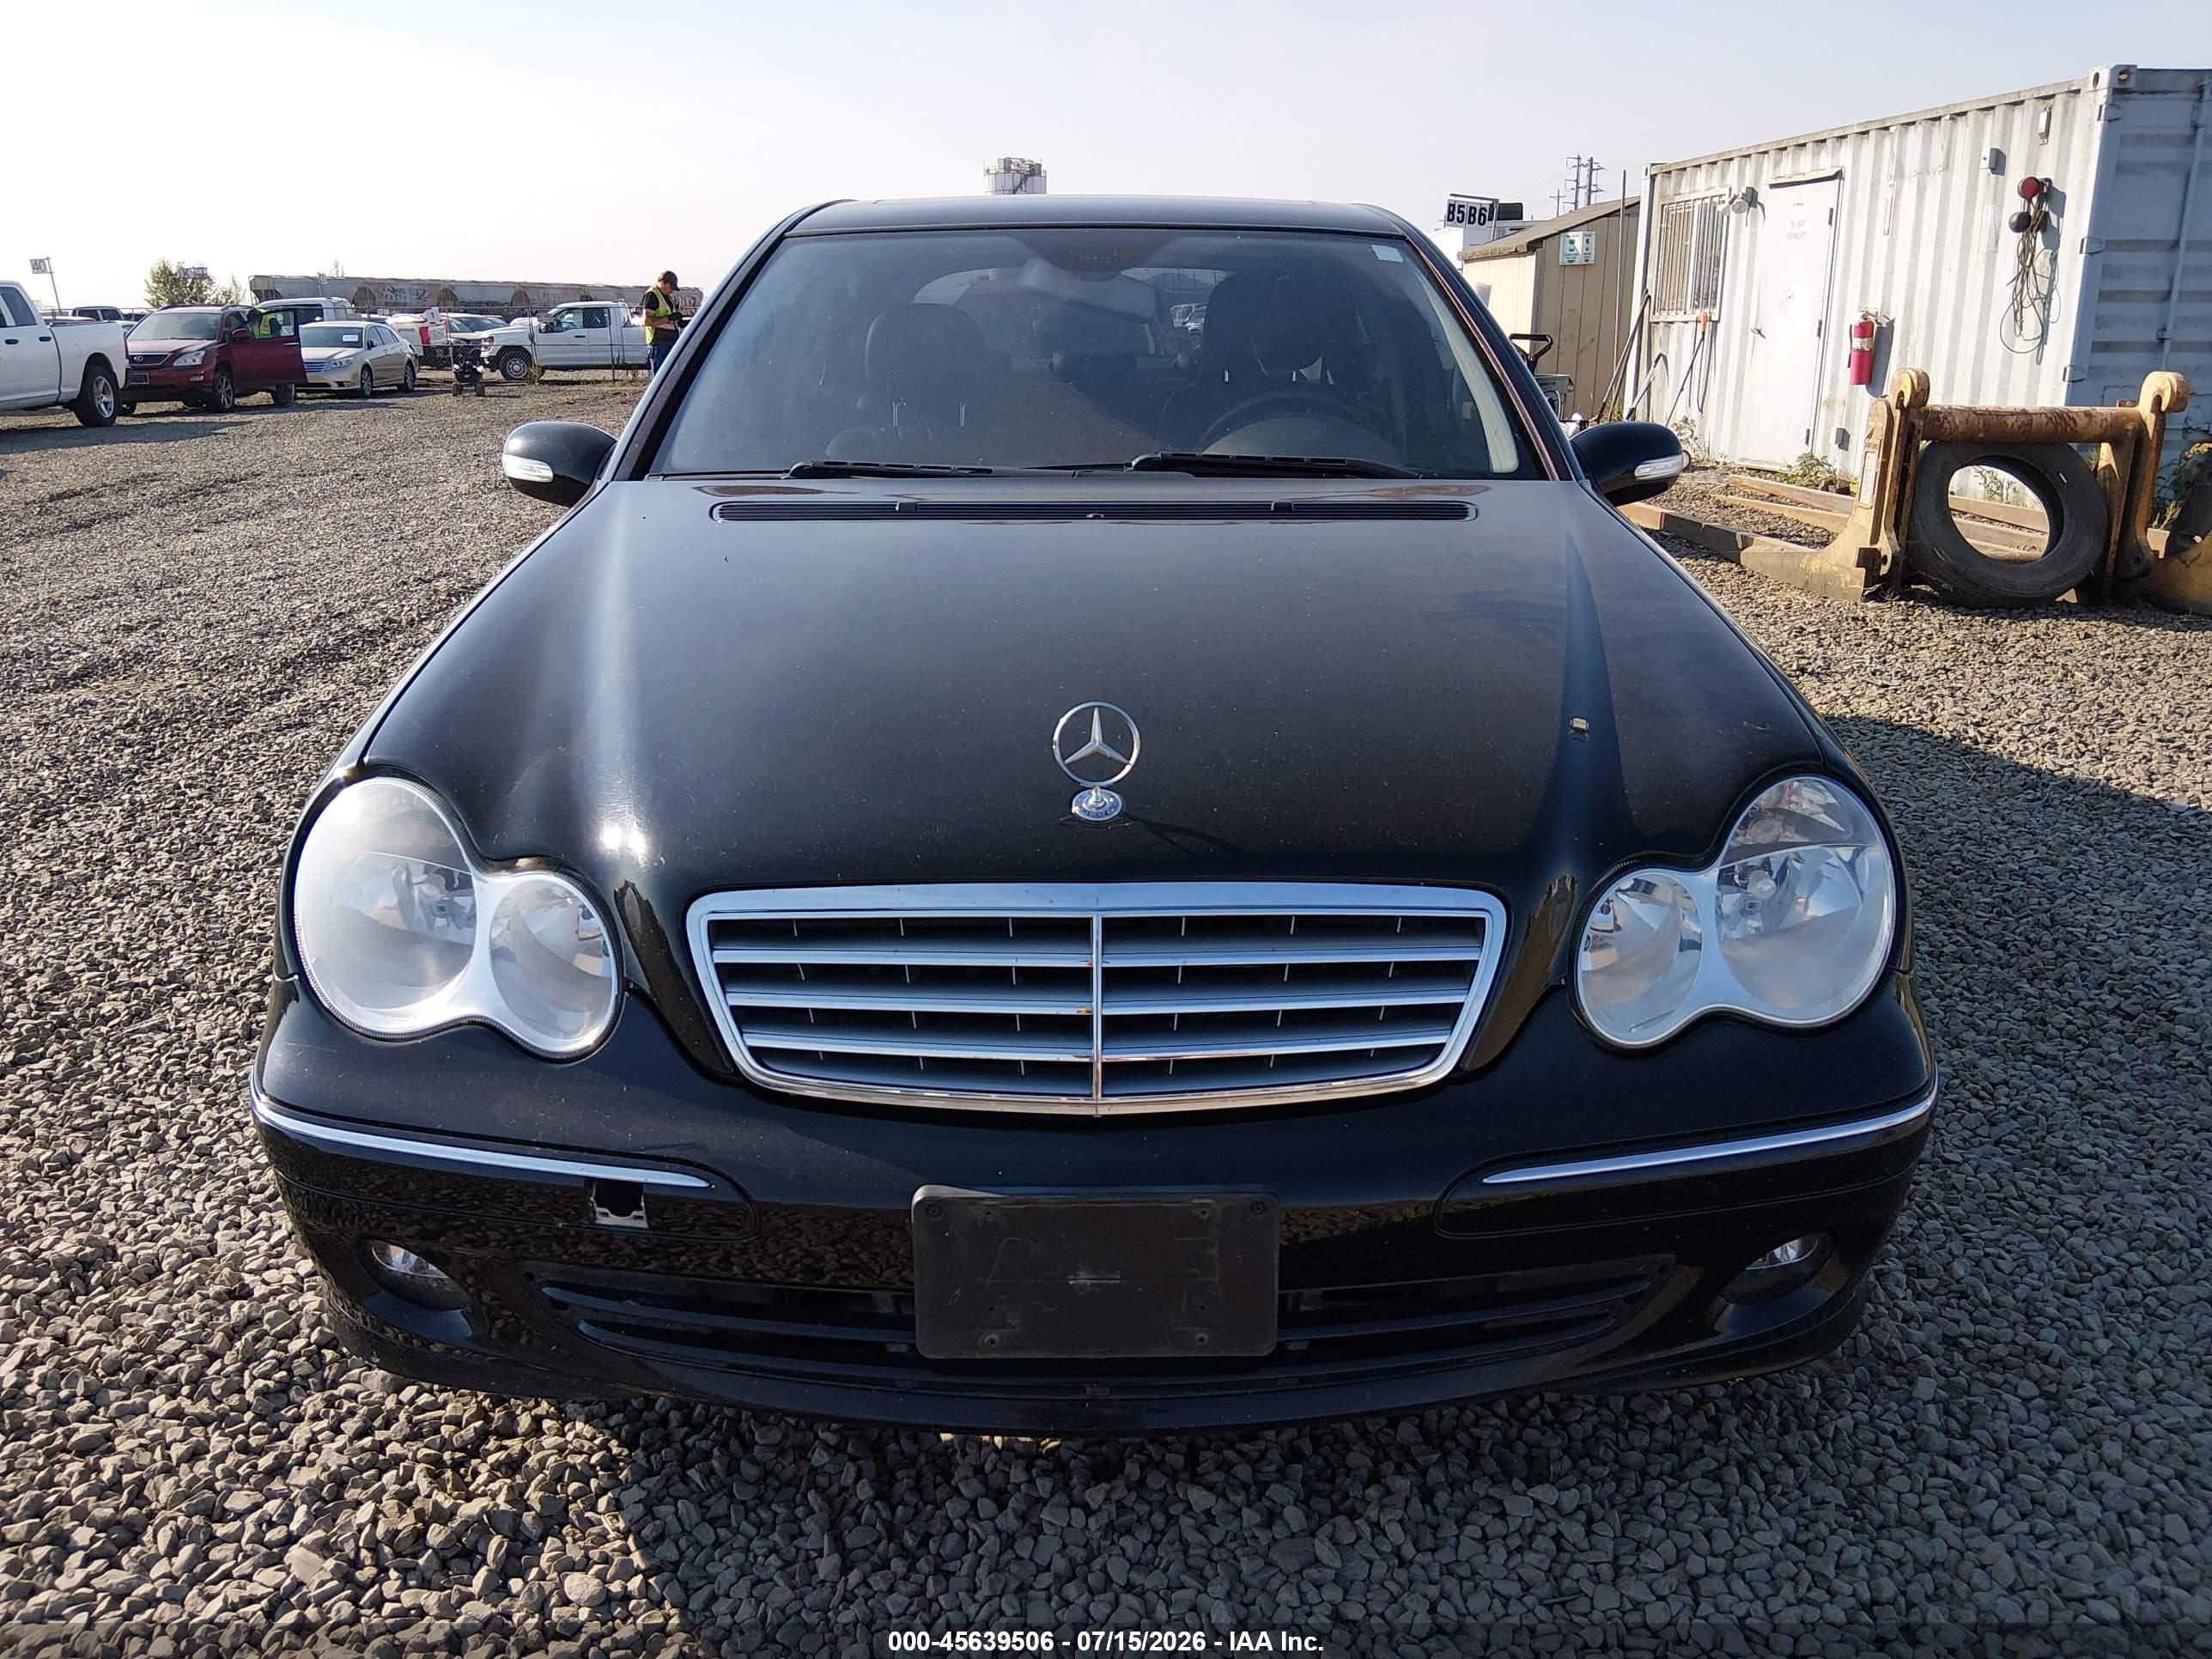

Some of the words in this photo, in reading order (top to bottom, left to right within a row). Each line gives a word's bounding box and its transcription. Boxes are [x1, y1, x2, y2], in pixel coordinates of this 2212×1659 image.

[1447, 203, 1466, 224] B5
[1468, 205, 1488, 227] B6
[33, 260, 47, 272] 40
